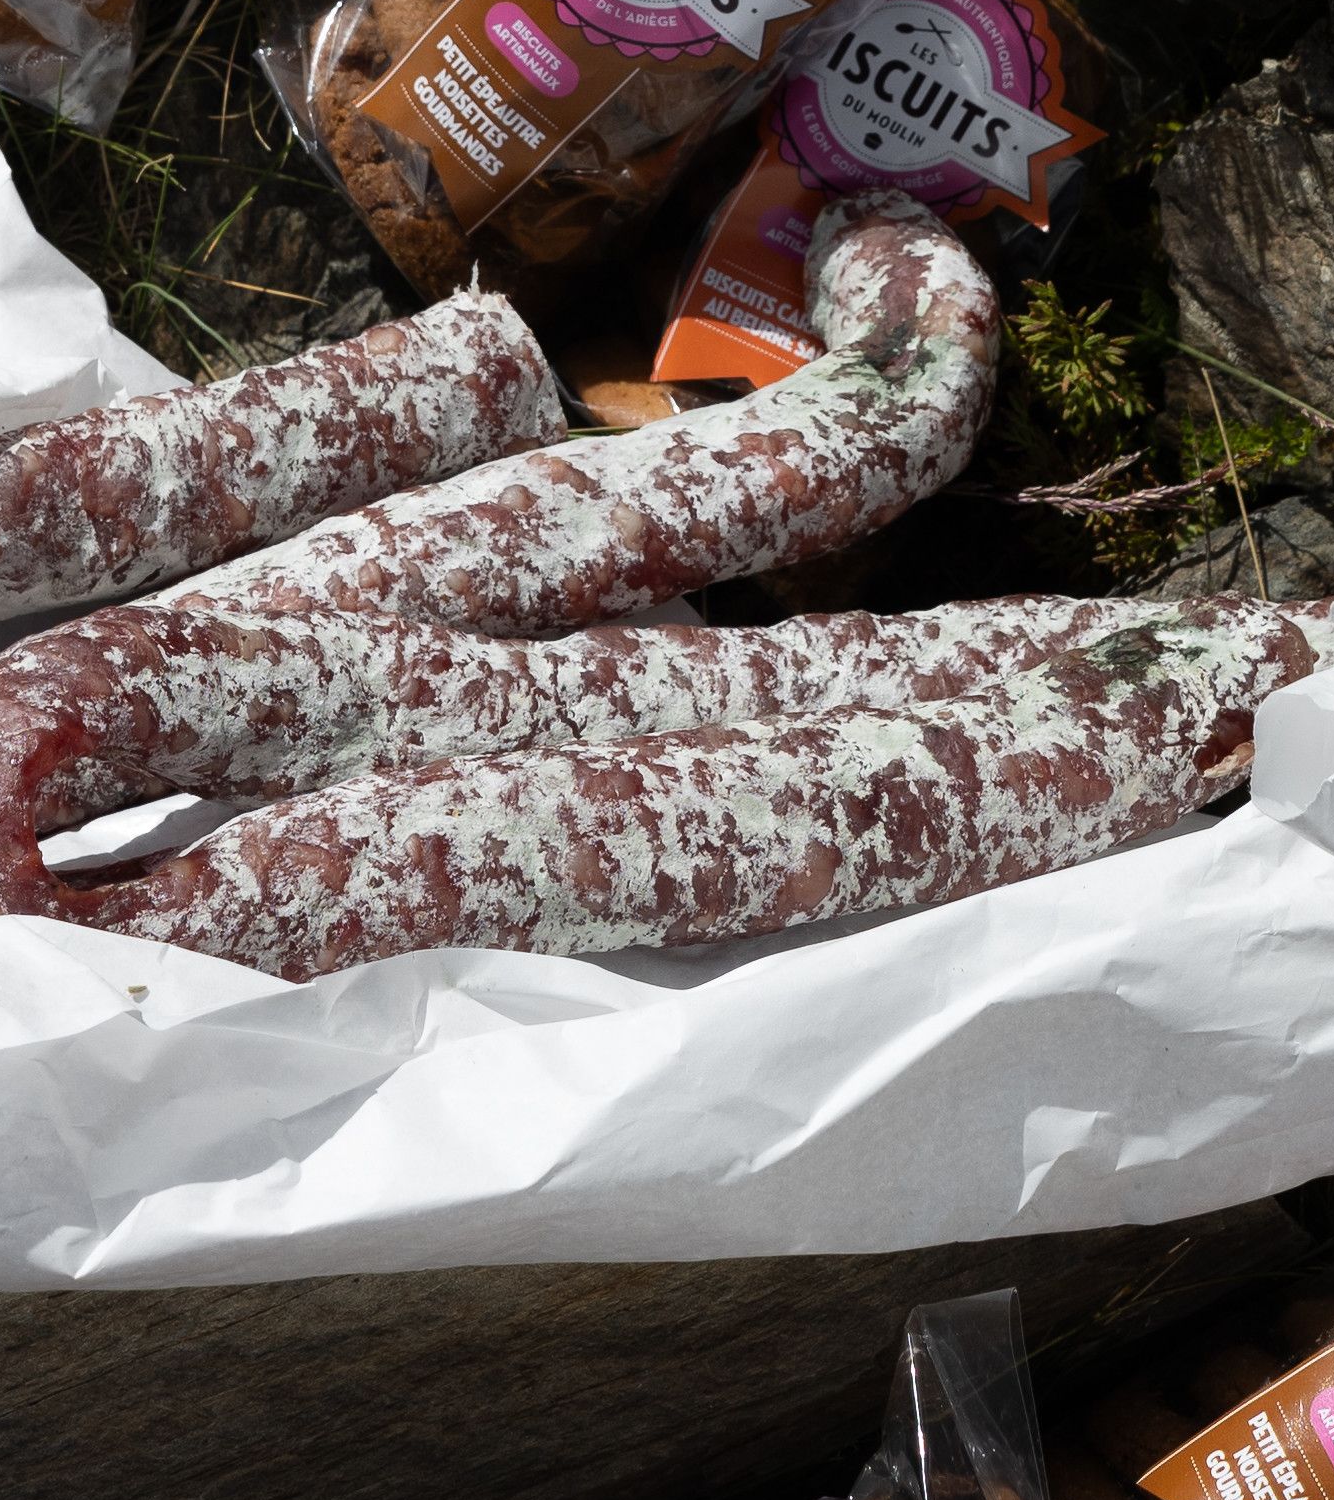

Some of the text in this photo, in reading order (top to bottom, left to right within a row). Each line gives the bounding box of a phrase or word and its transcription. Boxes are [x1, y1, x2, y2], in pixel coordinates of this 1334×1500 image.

[493, 23, 561, 91] ARTISANAUX
[512, 19, 561, 70] BISCUITS
[910, 42, 937, 66] LES
[433, 69, 508, 148] NOISETTES
[437, 35, 546, 149] PETIT ÉPEAUTRE
[826, 31, 1011, 159] ISCUITS
[841, 94, 927, 149] DU MOULIN
[413, 75, 505, 176] GOURMANDES
[702, 267, 777, 320] BISCUITS
[1248, 1411, 1286, 1463] PETIT
